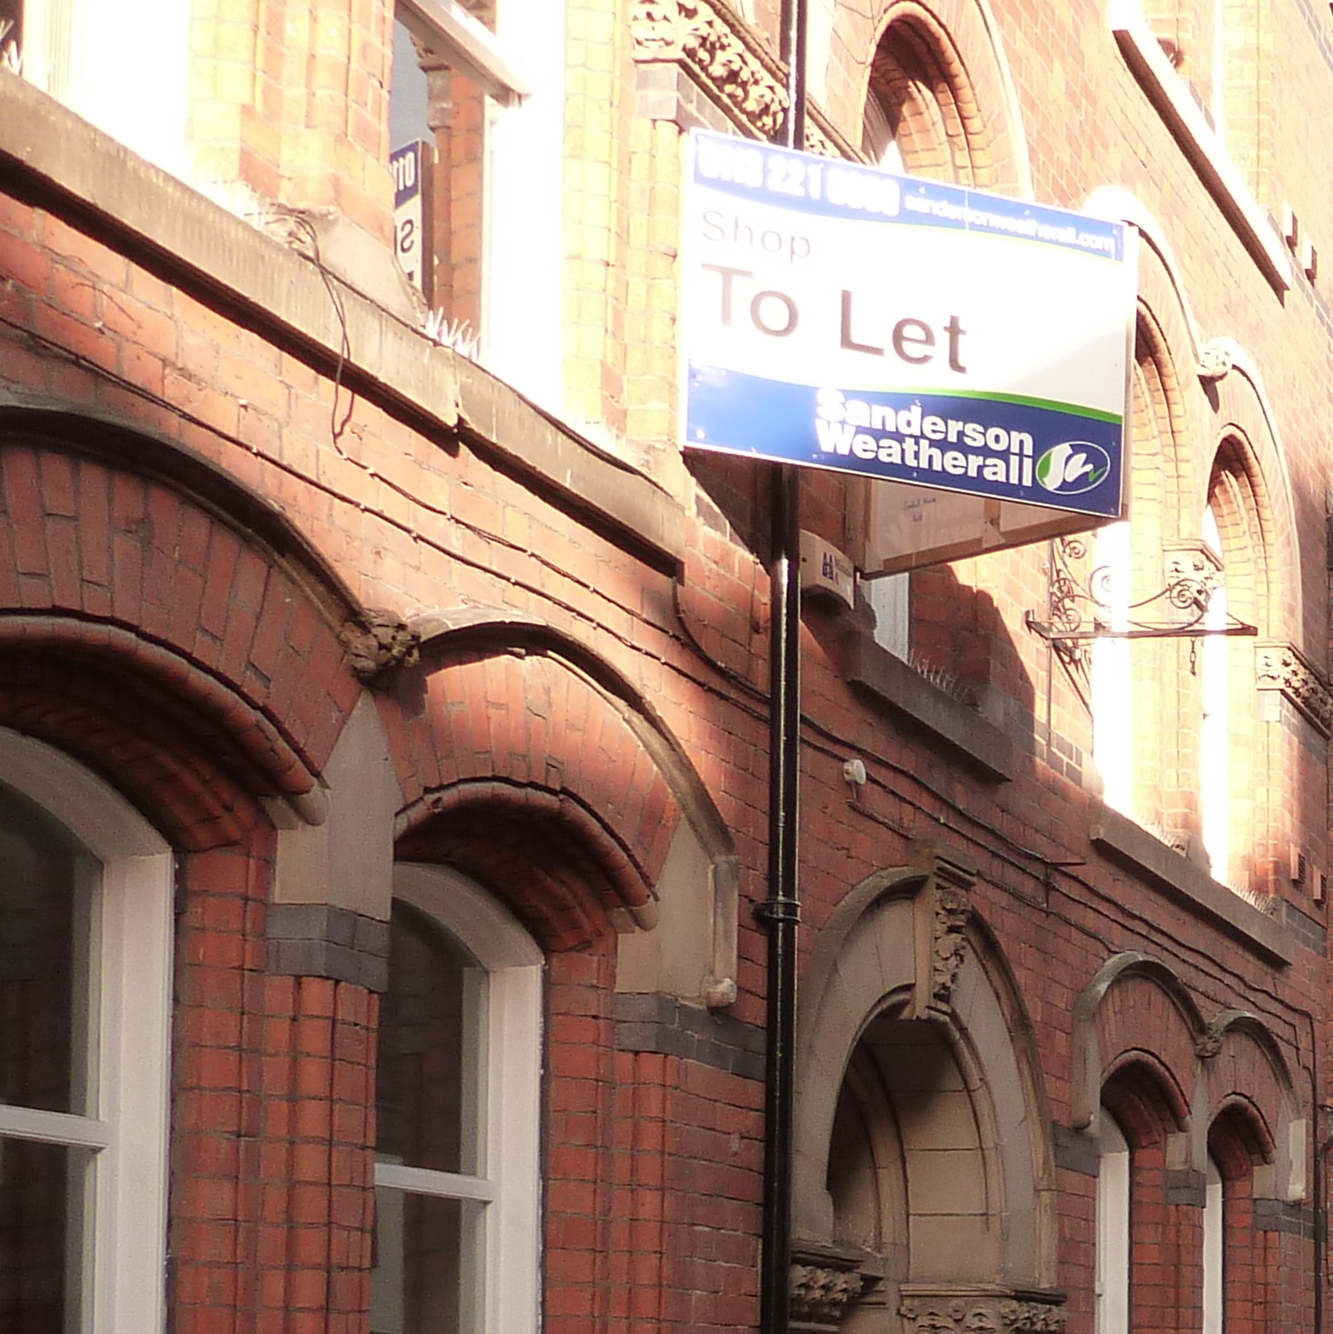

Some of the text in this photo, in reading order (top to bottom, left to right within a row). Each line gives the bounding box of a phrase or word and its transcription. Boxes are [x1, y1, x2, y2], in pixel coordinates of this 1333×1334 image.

[702, 209, 811, 264] Shop
[700, 262, 967, 374] To Let
[815, 387, 1034, 456] Sanderson
[815, 418, 1033, 487] Weatherall
